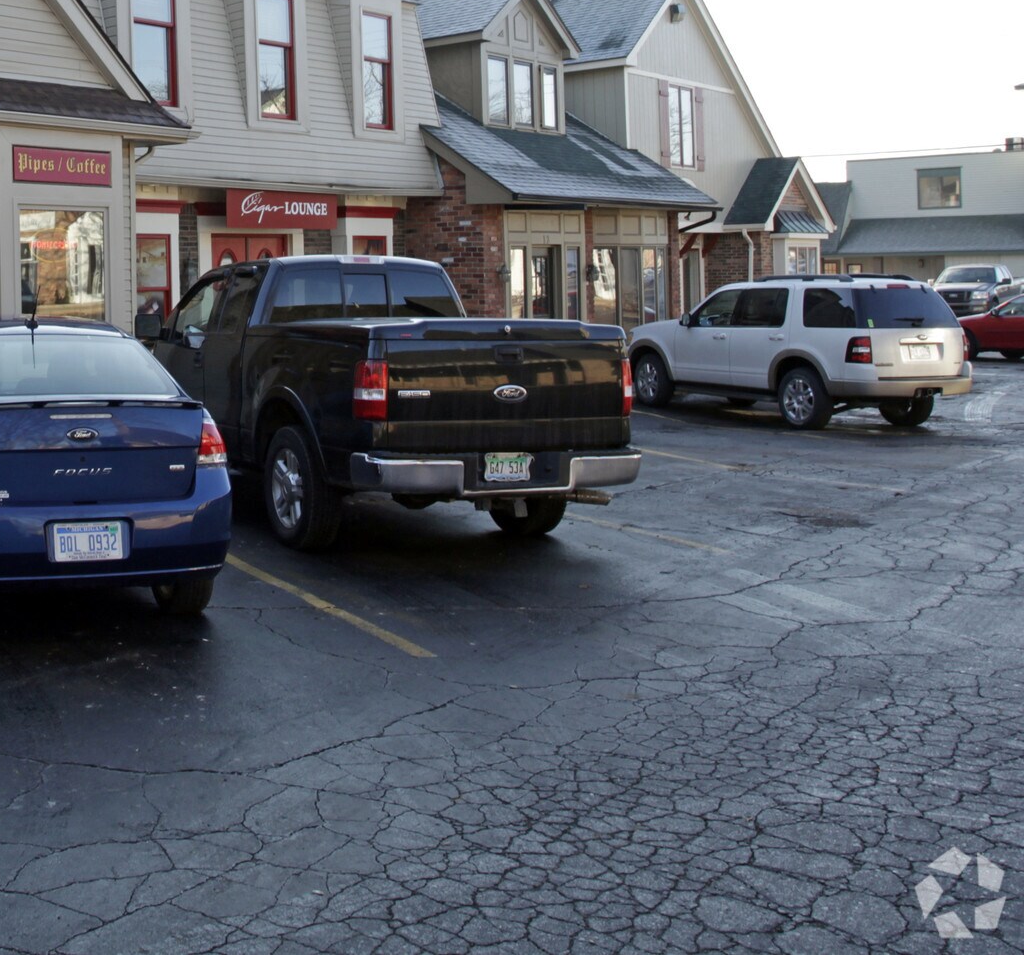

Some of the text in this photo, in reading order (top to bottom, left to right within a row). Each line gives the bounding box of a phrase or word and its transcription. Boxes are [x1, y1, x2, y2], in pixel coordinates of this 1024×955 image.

[18, 153, 55, 174] Pipes
[66, 157, 107, 175] Coffee
[240, 190, 328, 224] Cigar LOUNGE
[53, 467, 113, 477] FOCUS
[88, 533, 118, 551] 0932
